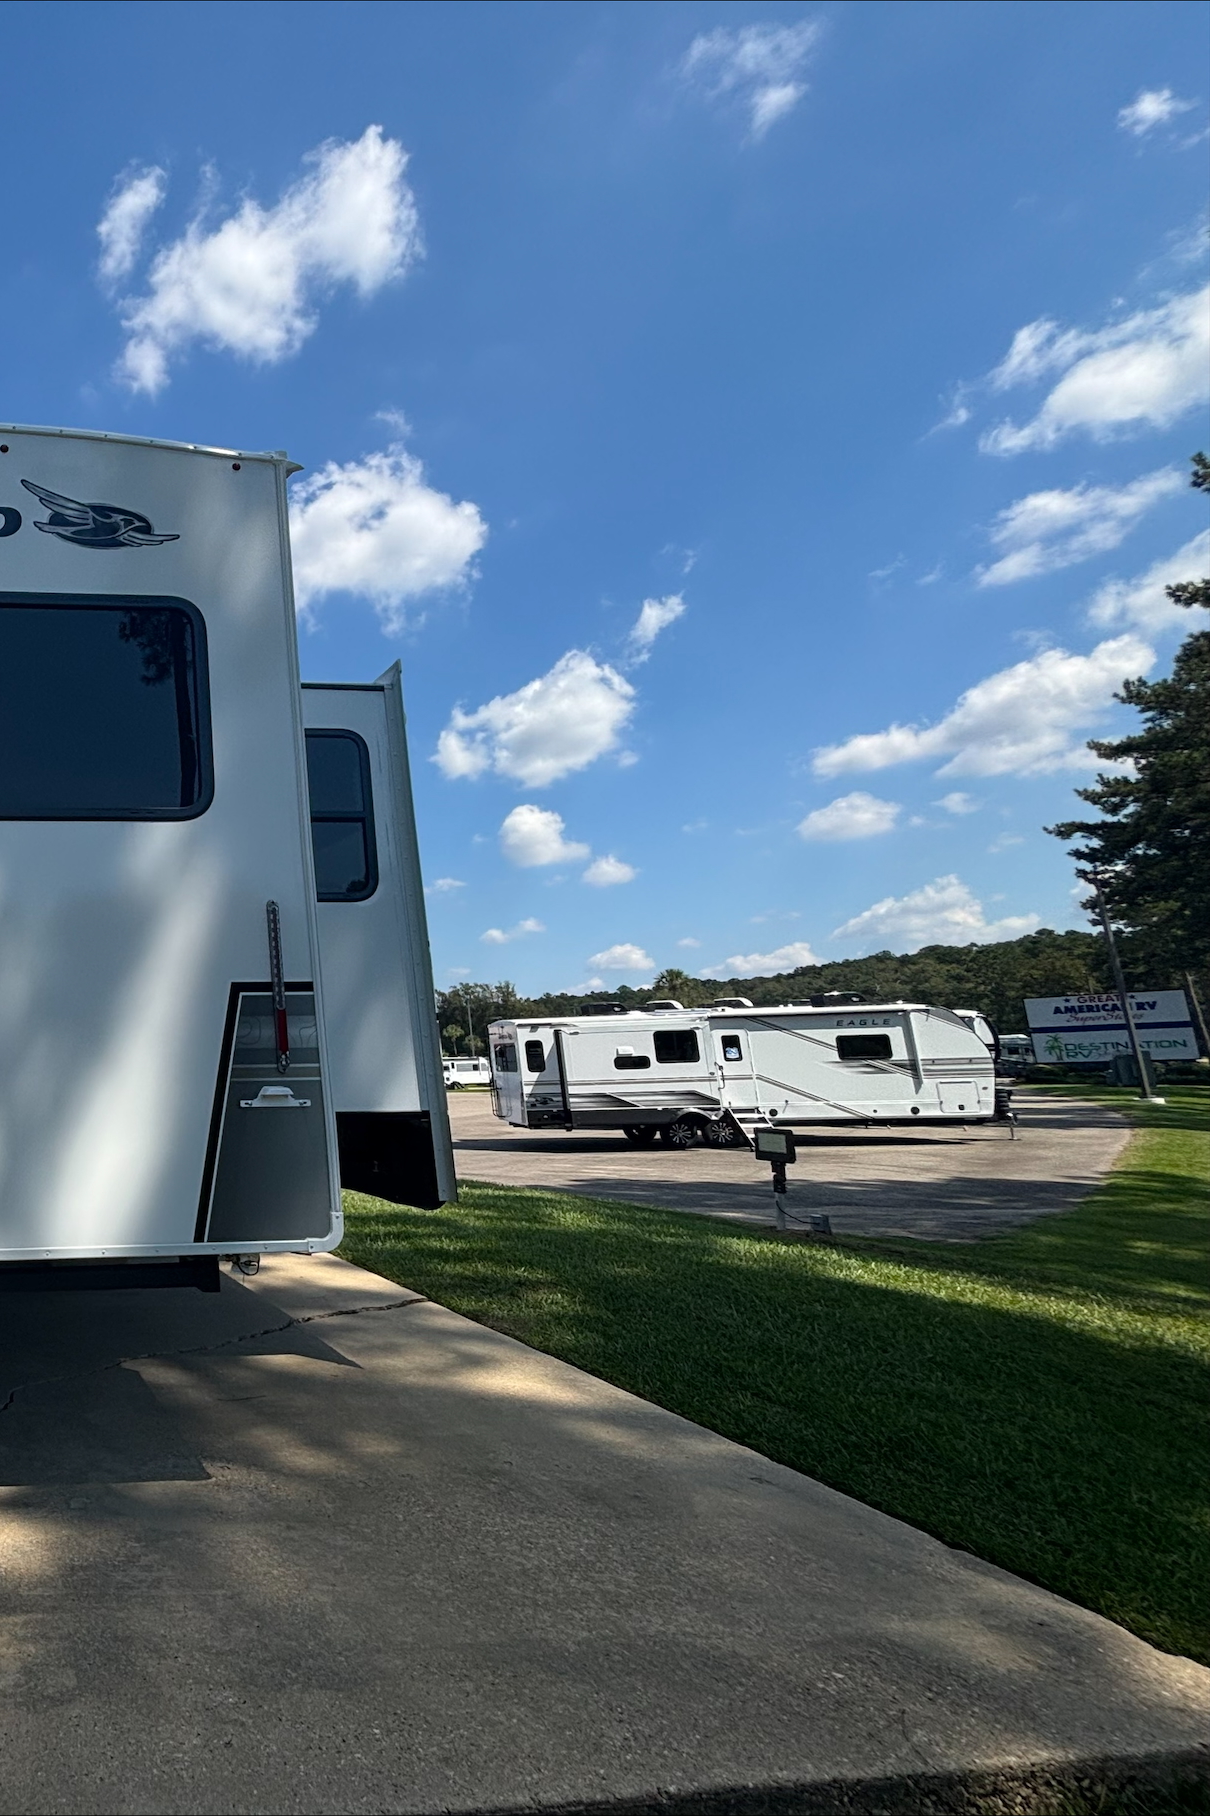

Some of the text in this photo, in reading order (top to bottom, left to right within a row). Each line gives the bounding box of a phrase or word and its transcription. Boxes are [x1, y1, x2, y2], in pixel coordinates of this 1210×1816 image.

[1076, 994, 1123, 1004] GREAT
[1136, 1001, 1157, 1011] RV
[836, 1018, 891, 1027] EAGLE
[1065, 1050, 1091, 1059] RV
